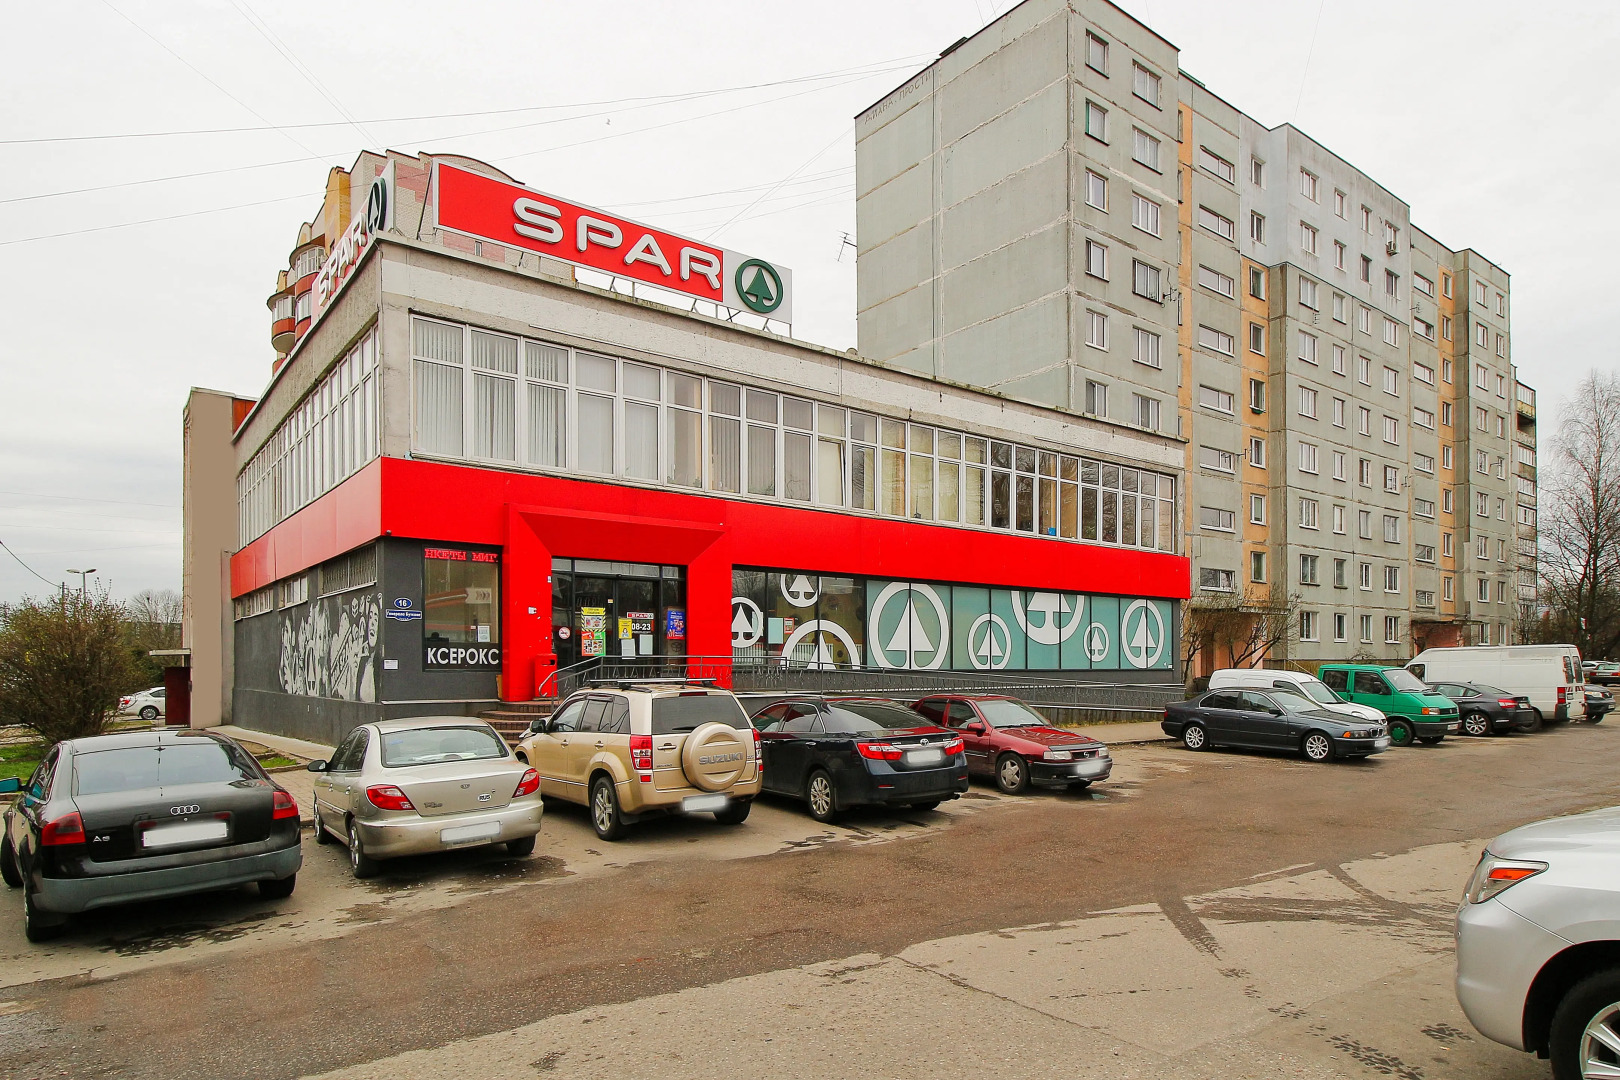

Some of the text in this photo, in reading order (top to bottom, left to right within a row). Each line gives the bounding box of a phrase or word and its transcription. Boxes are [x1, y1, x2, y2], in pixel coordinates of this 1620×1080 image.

[512, 196, 722, 291] SPAR
[317, 211, 367, 307] SPAR
[398, 599, 408, 607] 16
[631, 622, 651, 631] 08-23
[427, 647, 499, 665] КСЕРОКС
[699, 751, 744, 765] SUZUKI
[93, 835, 111, 843] A6
